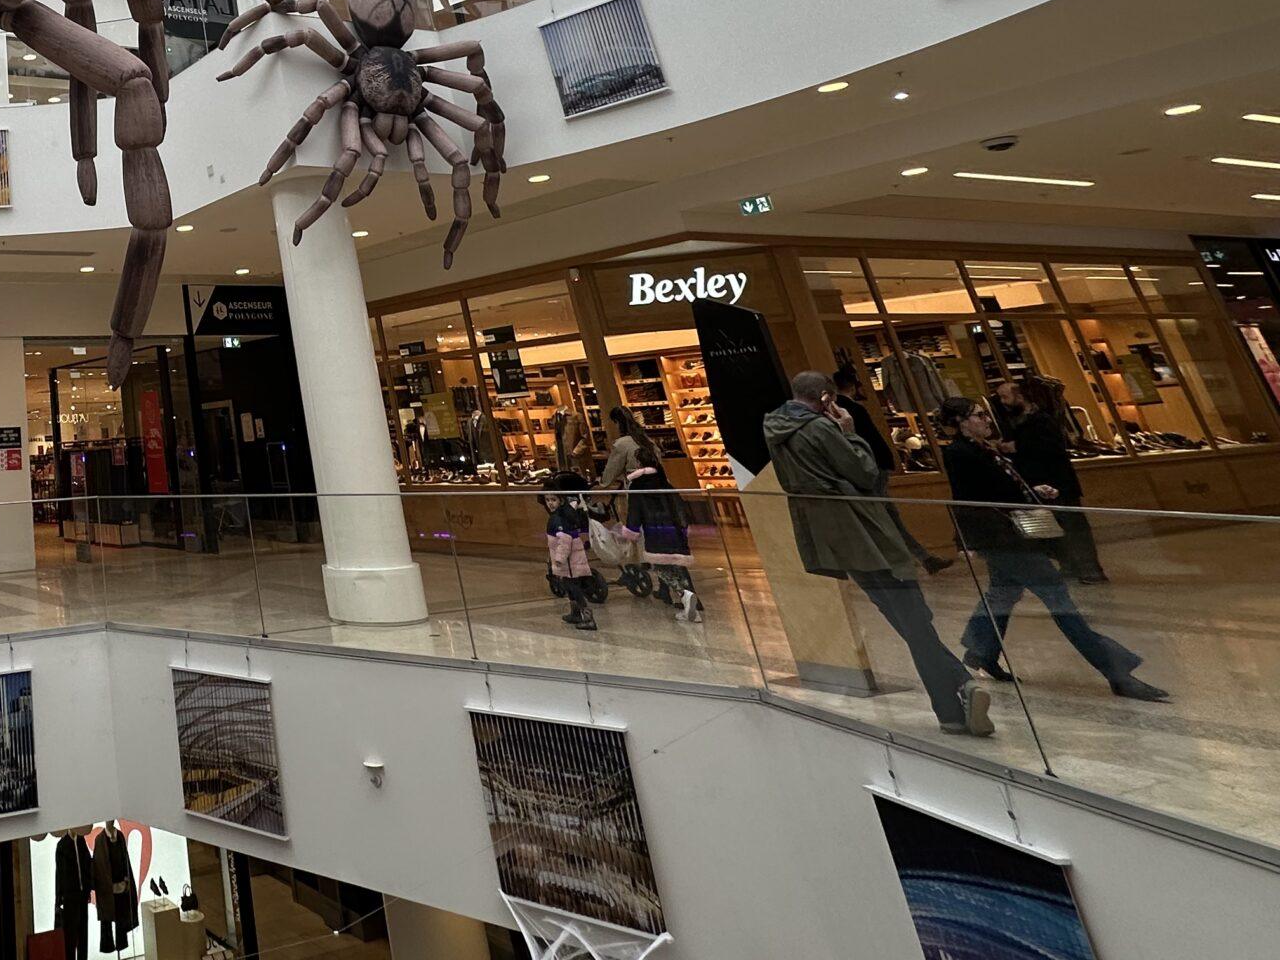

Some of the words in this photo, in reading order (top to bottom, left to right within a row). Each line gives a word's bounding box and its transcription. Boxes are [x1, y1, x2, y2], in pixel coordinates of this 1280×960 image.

[629, 266, 747, 305] Bexley
[228, 301, 273, 310] ASCENSEUR
[228, 312, 274, 321] POLYGONE
